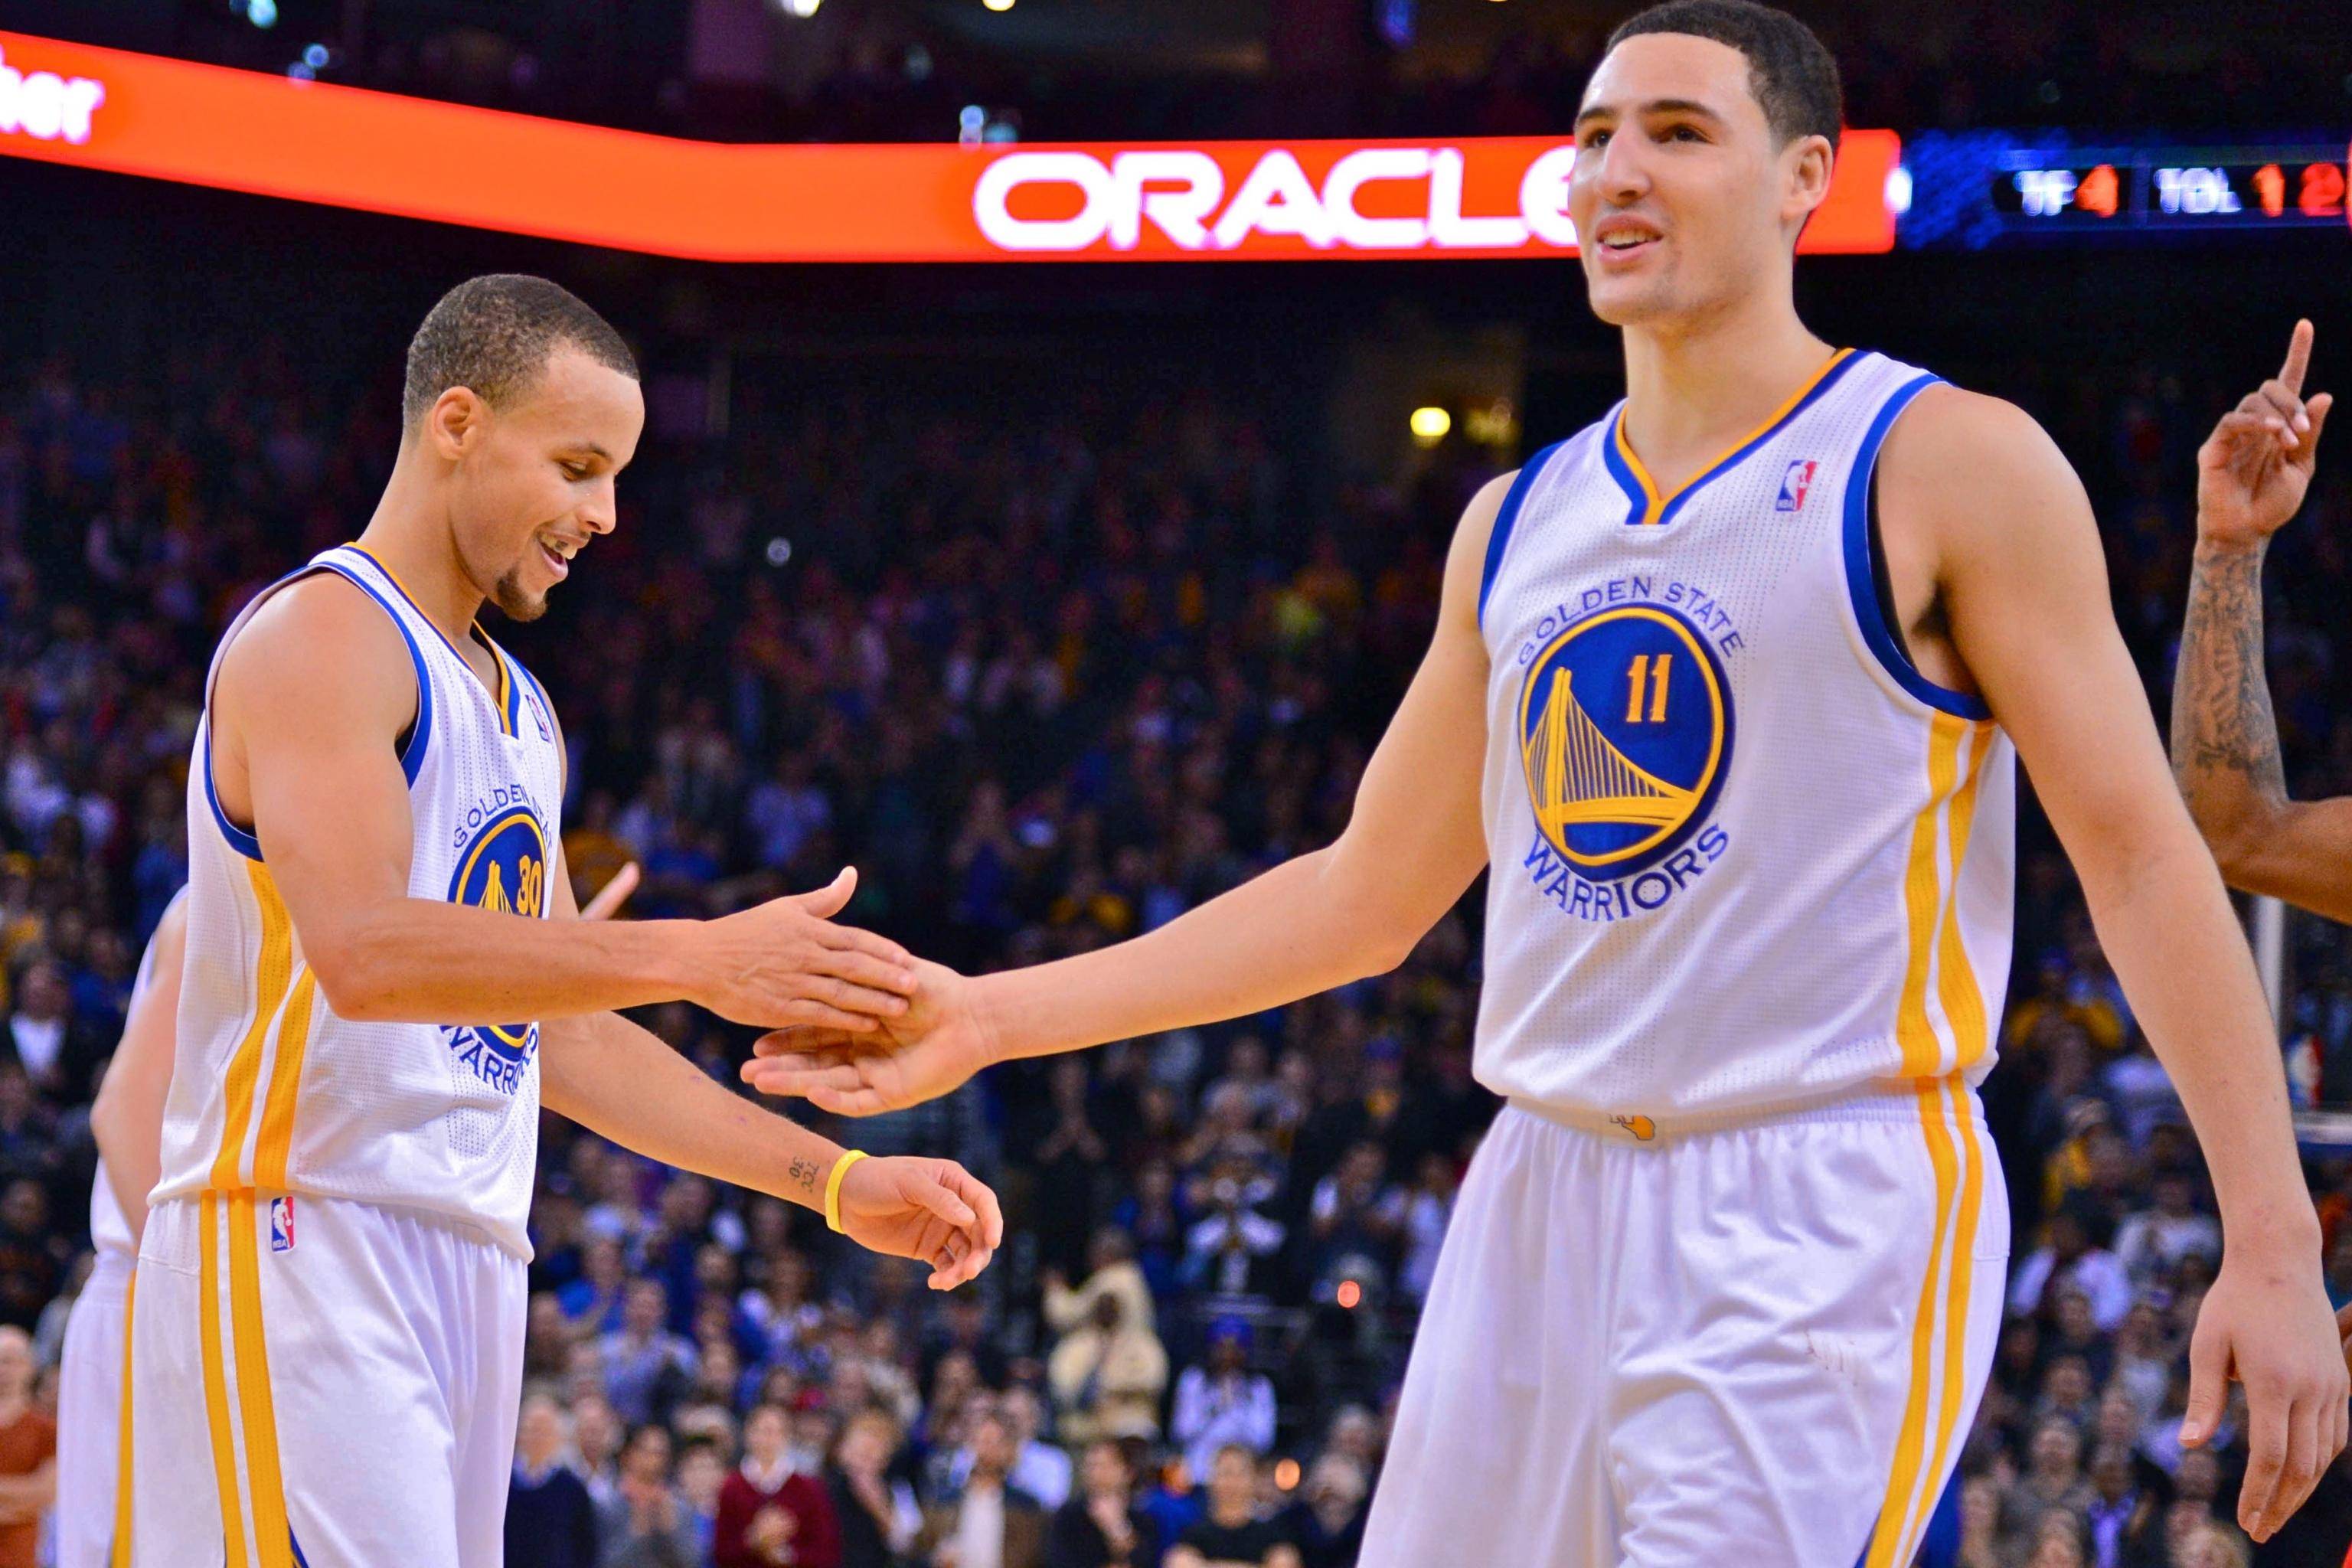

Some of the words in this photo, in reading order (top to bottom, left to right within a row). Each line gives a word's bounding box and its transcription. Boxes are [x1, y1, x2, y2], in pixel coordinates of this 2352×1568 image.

[2073, 163, 2119, 218] 4
[2251, 162, 2285, 217] 1
[1518, 576, 1651, 665] GOLDEN
[1664, 582, 1745, 658] STATE
[1626, 654, 1673, 723] 11
[453, 783, 530, 849] GOLDEN
[516, 854, 542, 918] 30
[1524, 823, 1730, 922] WARRIORS
